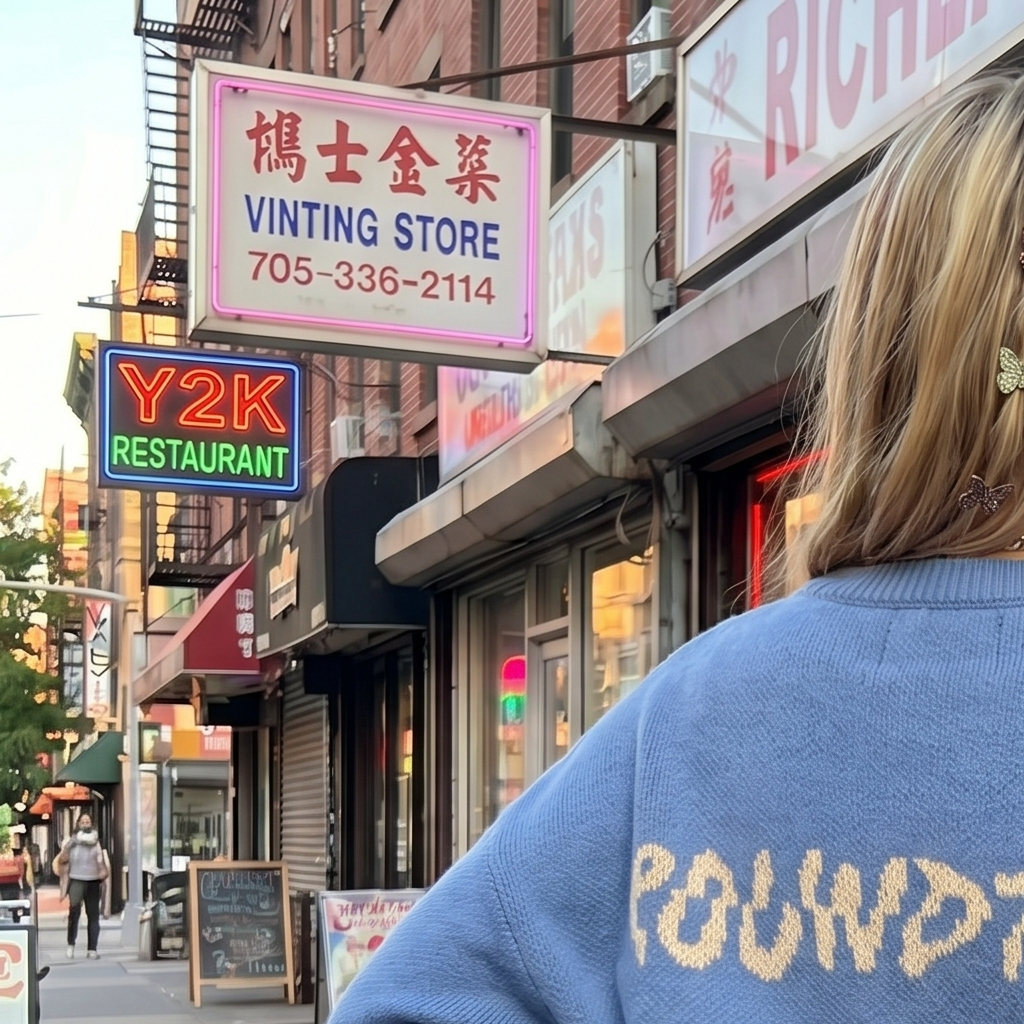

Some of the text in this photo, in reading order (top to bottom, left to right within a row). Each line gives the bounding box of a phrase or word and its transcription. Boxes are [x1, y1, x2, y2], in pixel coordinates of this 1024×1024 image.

[244, 194, 500, 260] VINTING STORE
[248, 251, 496, 305] 705-336-2114
[118, 362, 286, 433] Y2K
[112, 435, 289, 478] RESTAURANT
